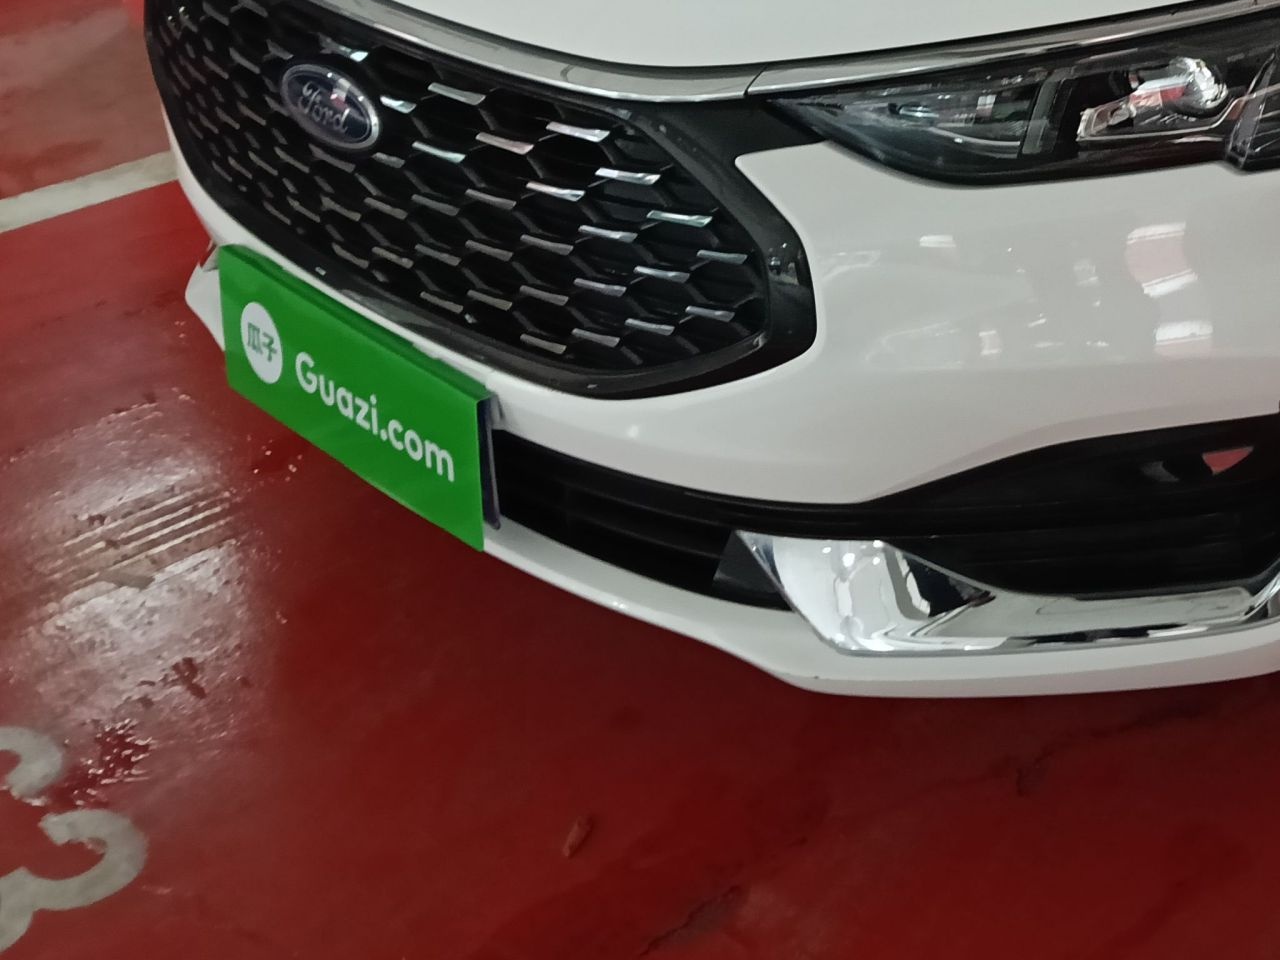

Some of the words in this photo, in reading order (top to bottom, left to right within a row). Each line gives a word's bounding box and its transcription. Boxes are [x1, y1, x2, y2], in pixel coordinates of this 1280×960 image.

[299, 81, 349, 133] Ford
[247, 321, 278, 362] 瓜子
[295, 351, 455, 482] Guazi.com
